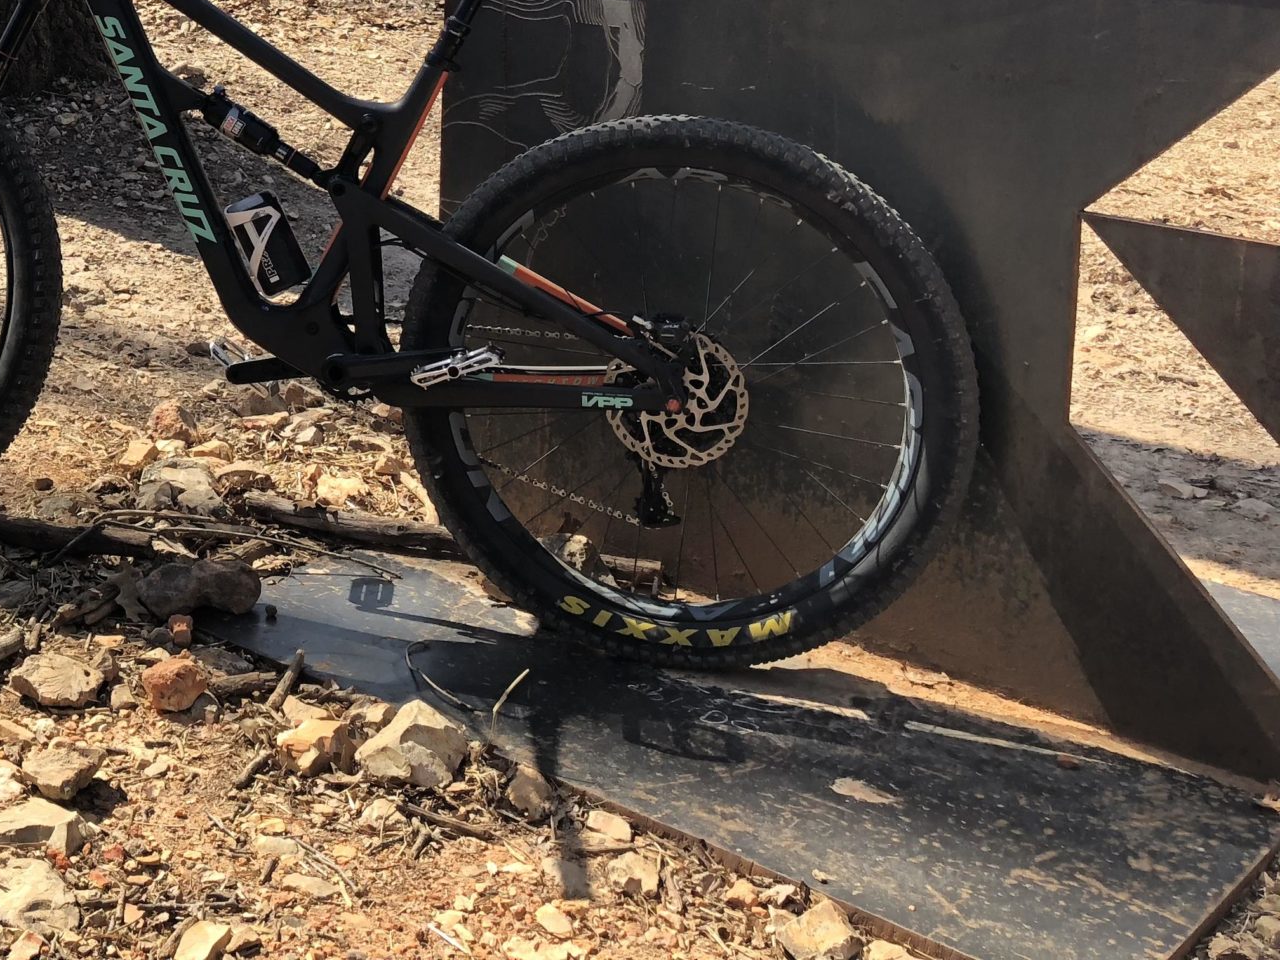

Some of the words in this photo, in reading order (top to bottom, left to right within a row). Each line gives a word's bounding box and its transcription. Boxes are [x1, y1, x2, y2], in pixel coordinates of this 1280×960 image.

[95, 15, 168, 140] SANTA
[154, 145, 217, 243] CRUZ
[582, 395, 633, 408] VPP
[560, 595, 792, 647] MAXXIS
